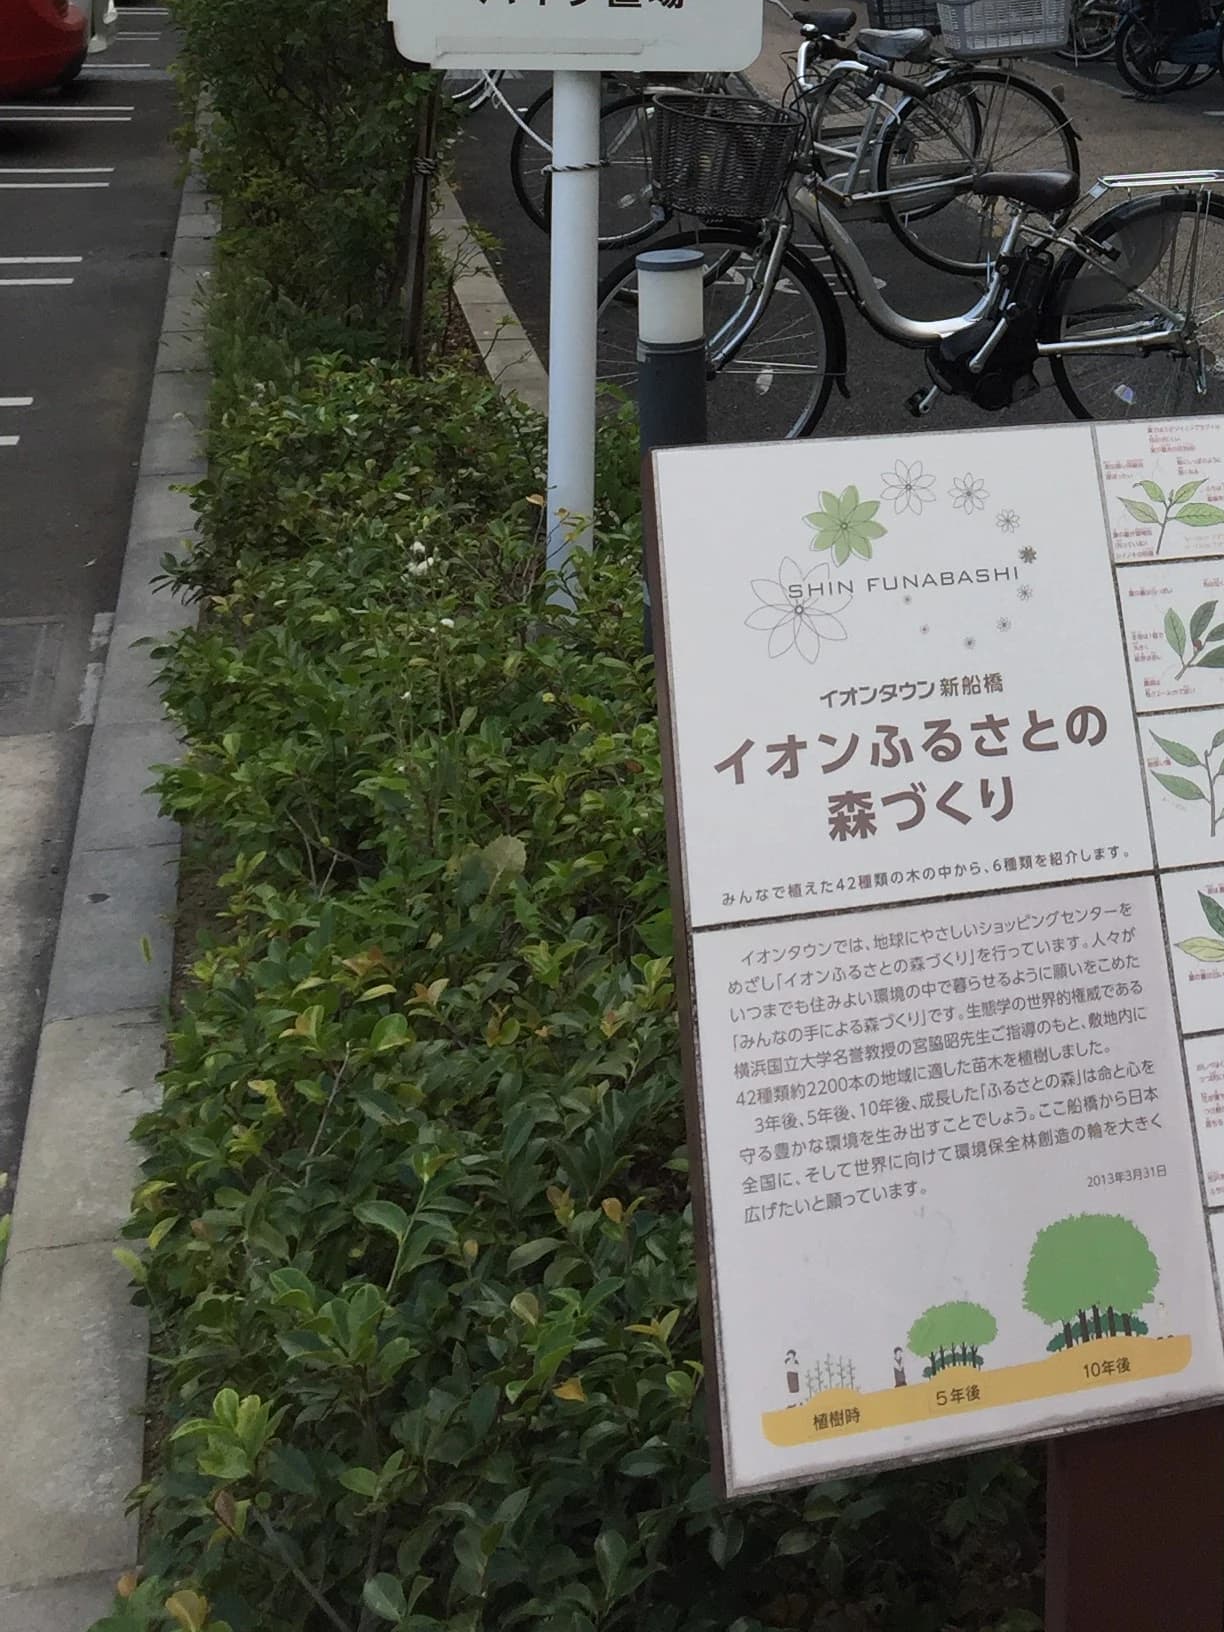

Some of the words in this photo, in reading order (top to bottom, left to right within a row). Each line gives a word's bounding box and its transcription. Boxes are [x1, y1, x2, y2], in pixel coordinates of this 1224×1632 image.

[788, 579, 855, 599] SHIN
[867, 566, 1018, 592] FUNABASHI
[819, 672, 1003, 708] イオンタウン新船橋
[713, 705, 1107, 784] イオンふるさとの
[827, 775, 1013, 841] 森づくり
[722, 845, 1128, 905] みんなで植えた42種類の木の中から、6種類を紹介します。
[1087, 1164, 1167, 1187] 2013年3月31日
[744, 1179, 926, 1223] 広げたいと願っています。
[1083, 1356, 1130, 1378] 10年後
[935, 1384, 980, 1406] 5年後
[813, 1406, 860, 1431] 植樹時
